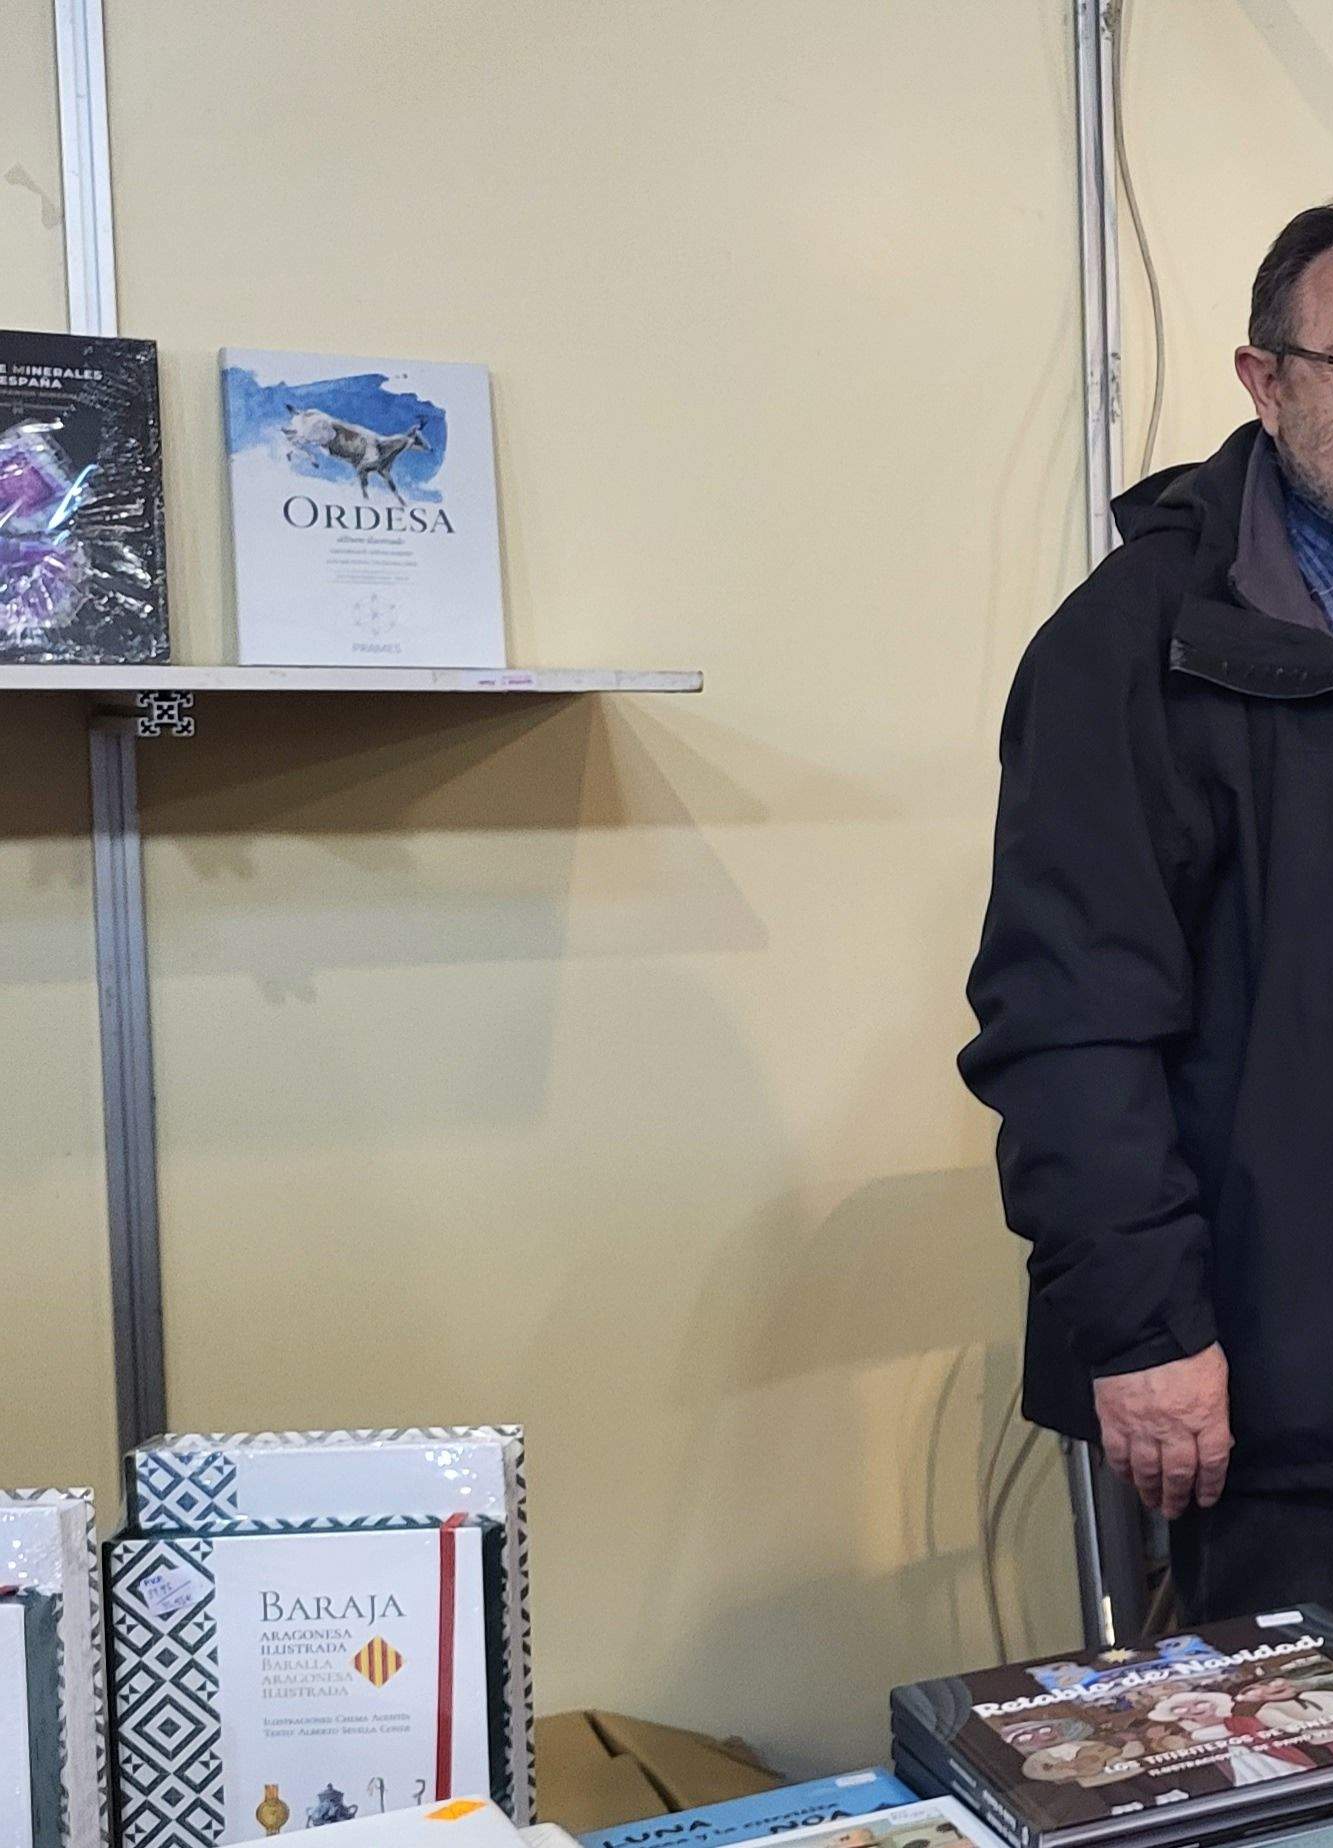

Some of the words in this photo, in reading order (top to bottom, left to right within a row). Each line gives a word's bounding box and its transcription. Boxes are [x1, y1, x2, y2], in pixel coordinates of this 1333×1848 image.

[13, 363, 103, 380] MINERALES
[283, 494, 456, 534] ORDESA
[260, 1629, 353, 1643] ARAGONESA
[260, 1642, 348, 1656] ILUSTRADA
[261, 1672, 354, 1686] ARAGONESA
[970, 1680, 1116, 1719] Retablo
[1119, 1667, 1169, 1689] de
[1171, 1634, 1325, 1675] Navidad
[262, 1686, 350, 1700] ILUSTRADA
[769, 1808, 854, 1836] NOA
